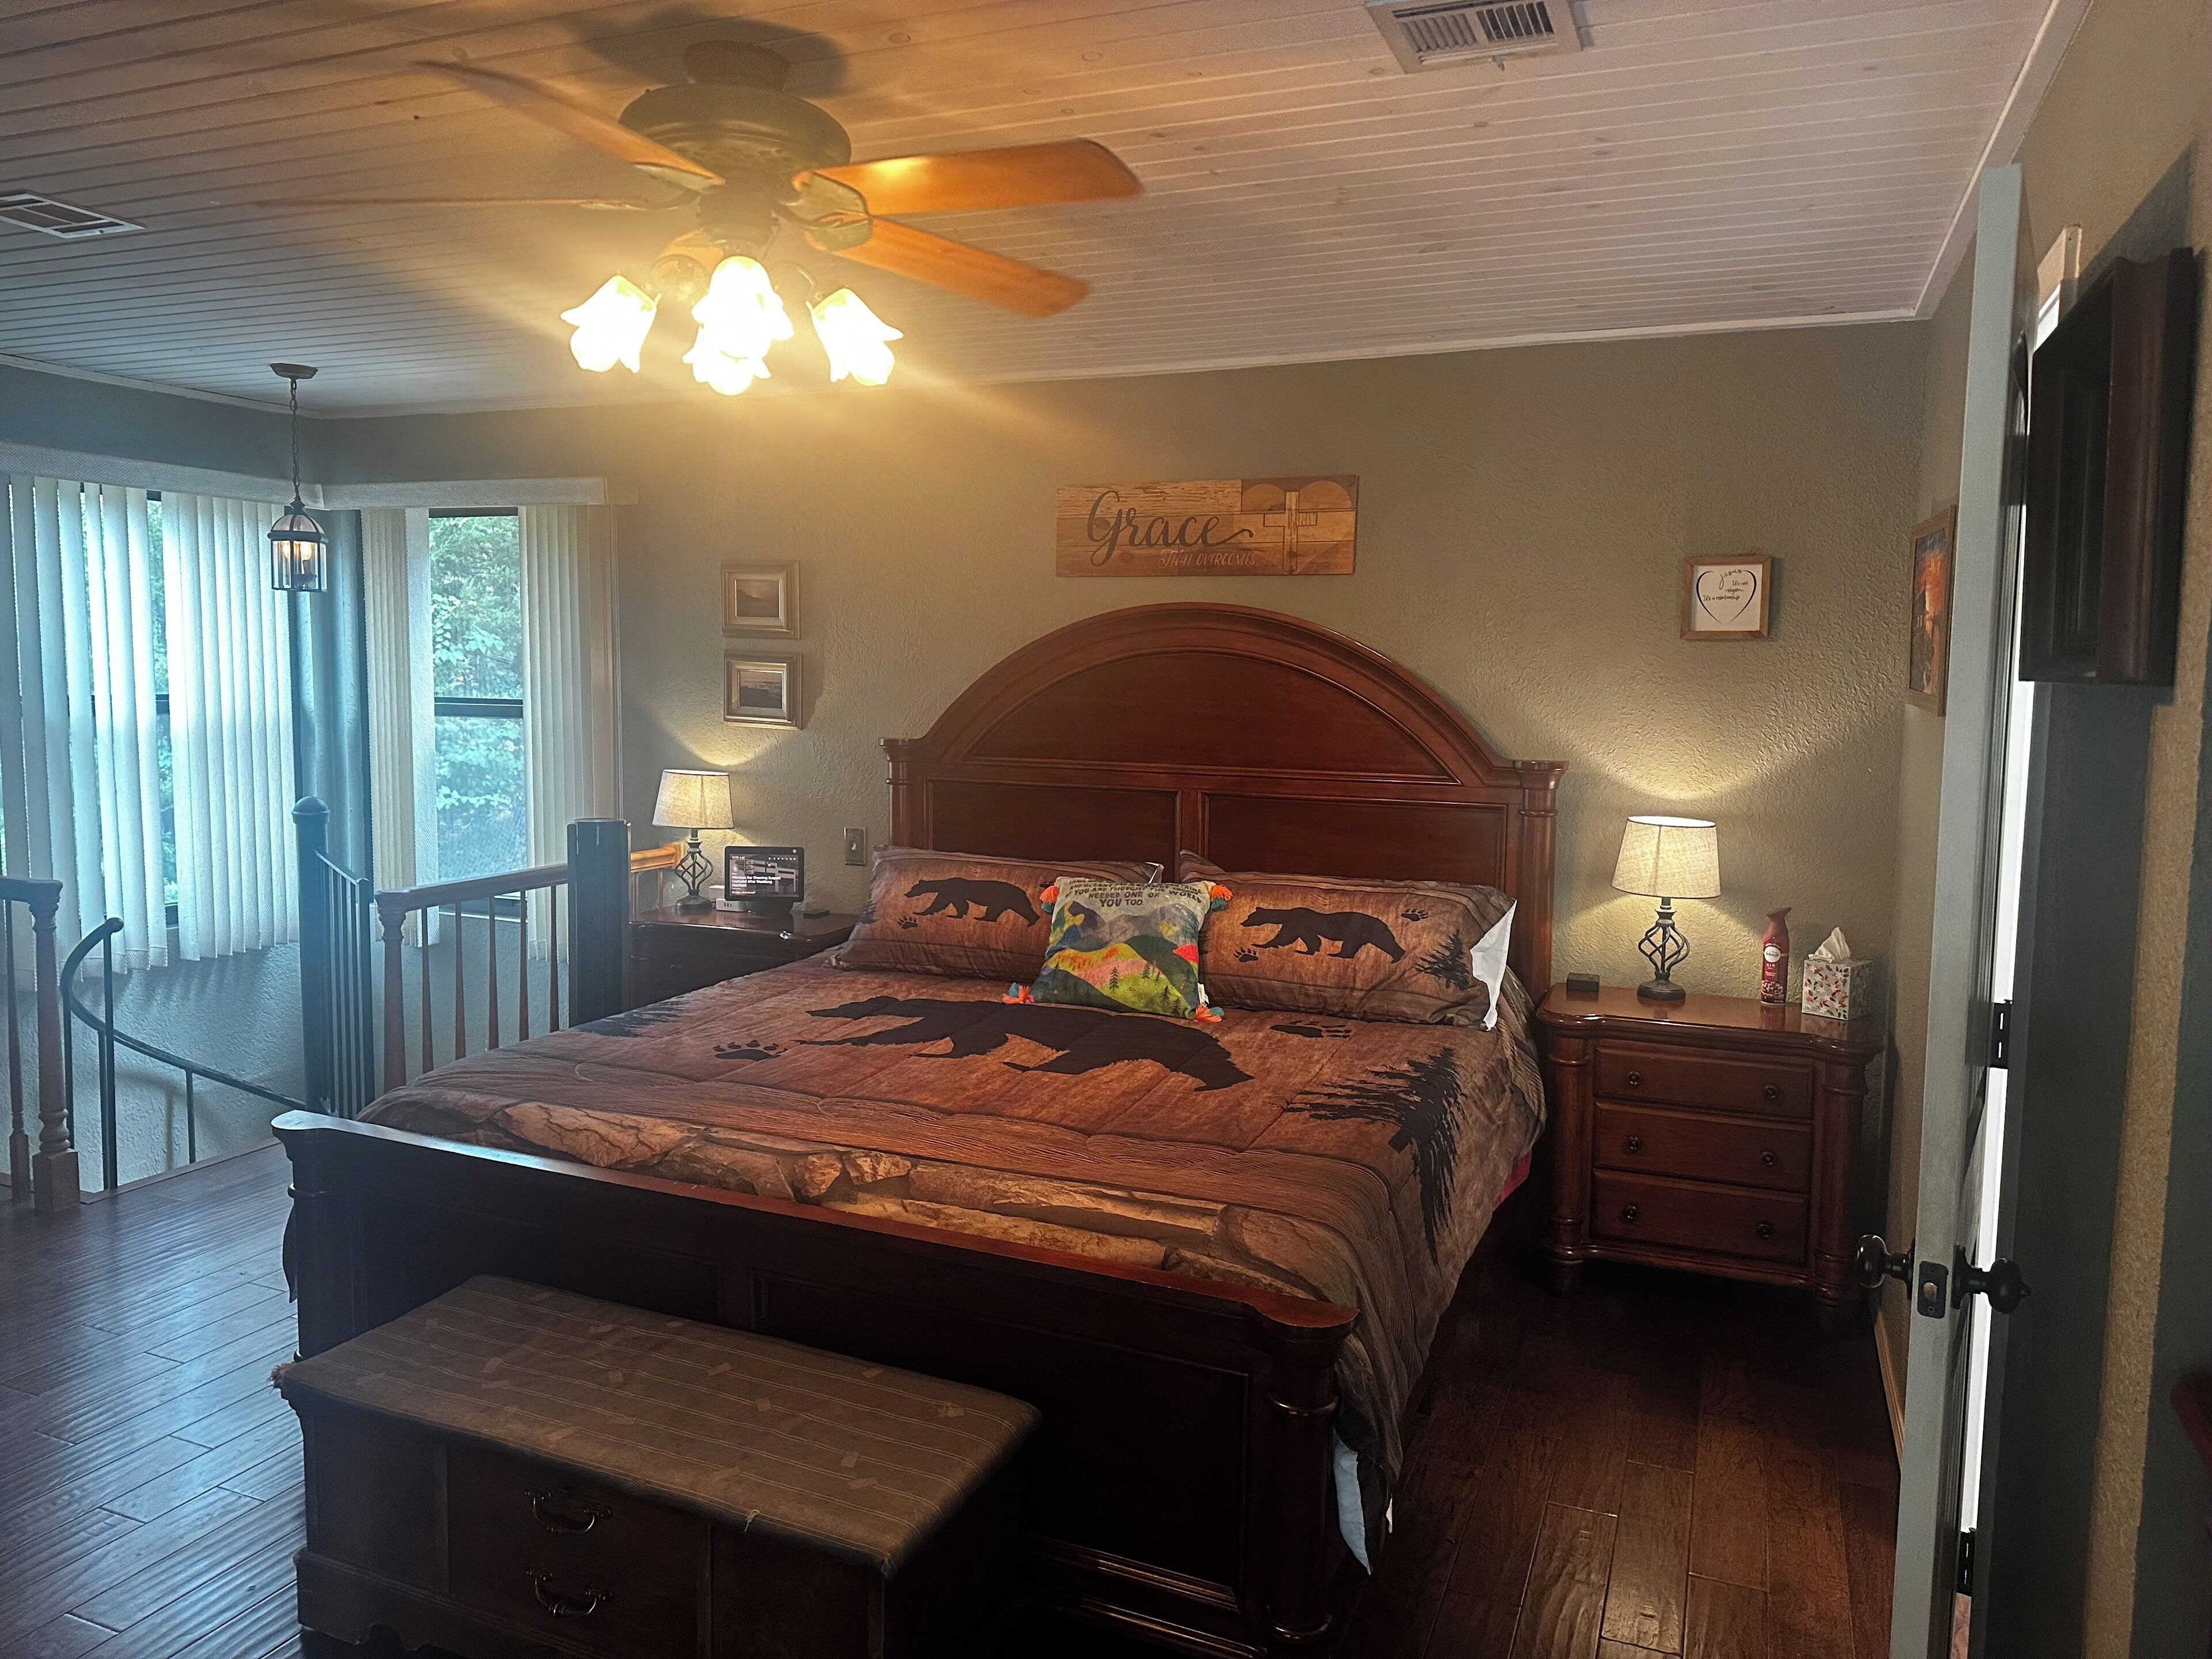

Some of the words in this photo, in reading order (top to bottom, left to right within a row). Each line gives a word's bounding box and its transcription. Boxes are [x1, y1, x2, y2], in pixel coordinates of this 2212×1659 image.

[1087, 490, 1253, 566] Grace
[1719, 569, 1742, 590] Jesus
[1100, 899, 1122, 908] YOU
[1169, 890, 1202, 903] WORLD
